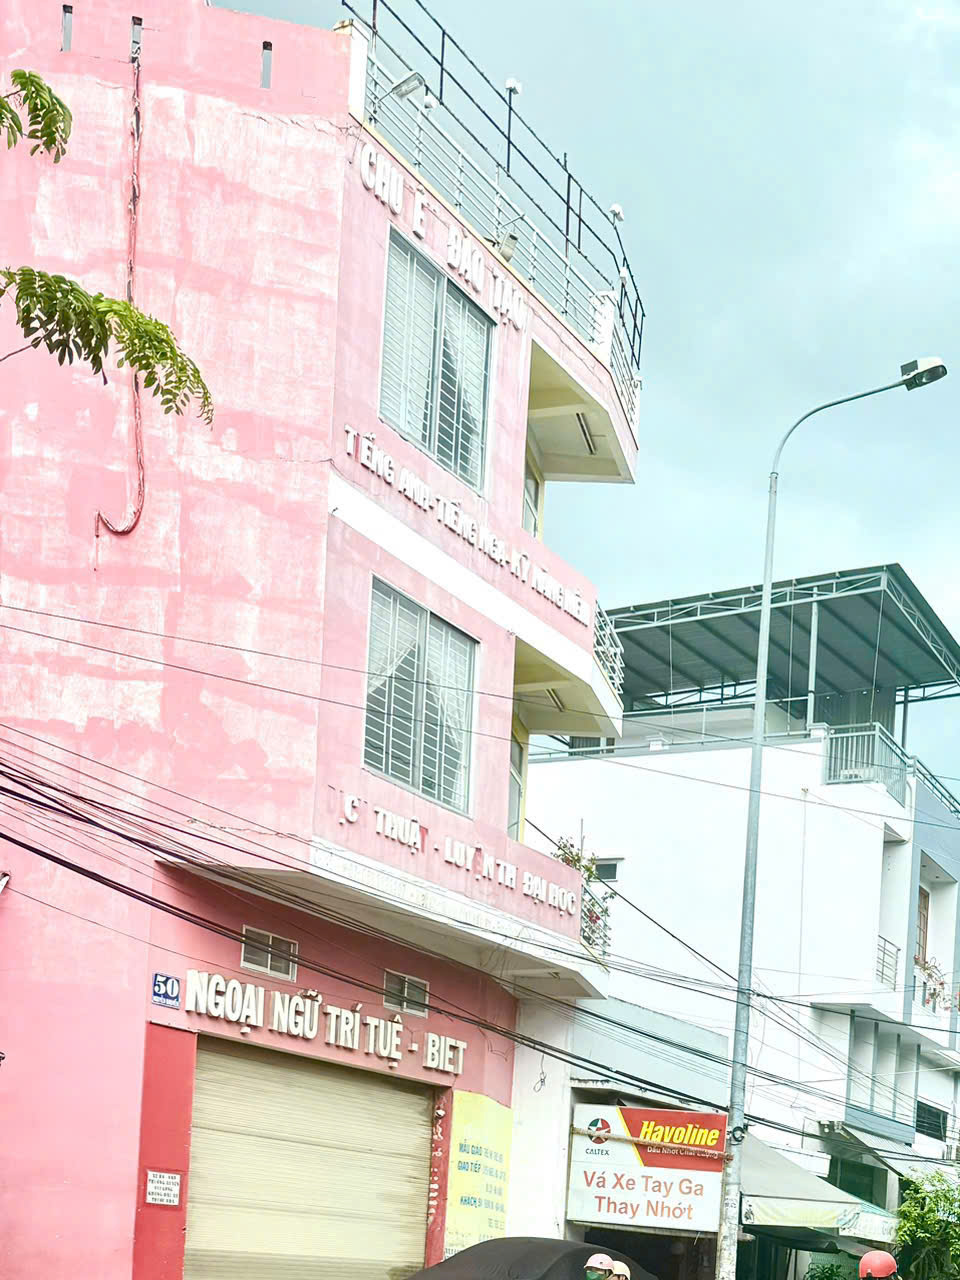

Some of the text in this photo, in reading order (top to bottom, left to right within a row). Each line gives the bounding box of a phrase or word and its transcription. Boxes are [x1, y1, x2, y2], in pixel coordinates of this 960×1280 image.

[154, 974, 179, 998] 50
[185, 968, 265, 1036] NGOẠI
[269, 989, 322, 1040] NGỮ
[324, 1003, 363, 1050] TRÍ
[362, 1014, 404, 1068] TUỆ
[423, 1031, 467, 1075] BIET
[585, 1120, 721, 1156] CALTEX Havoline
[583, 1170, 704, 1198] Vá Xe Tay Ga
[594, 1196, 693, 1220] Thay Nhớt
